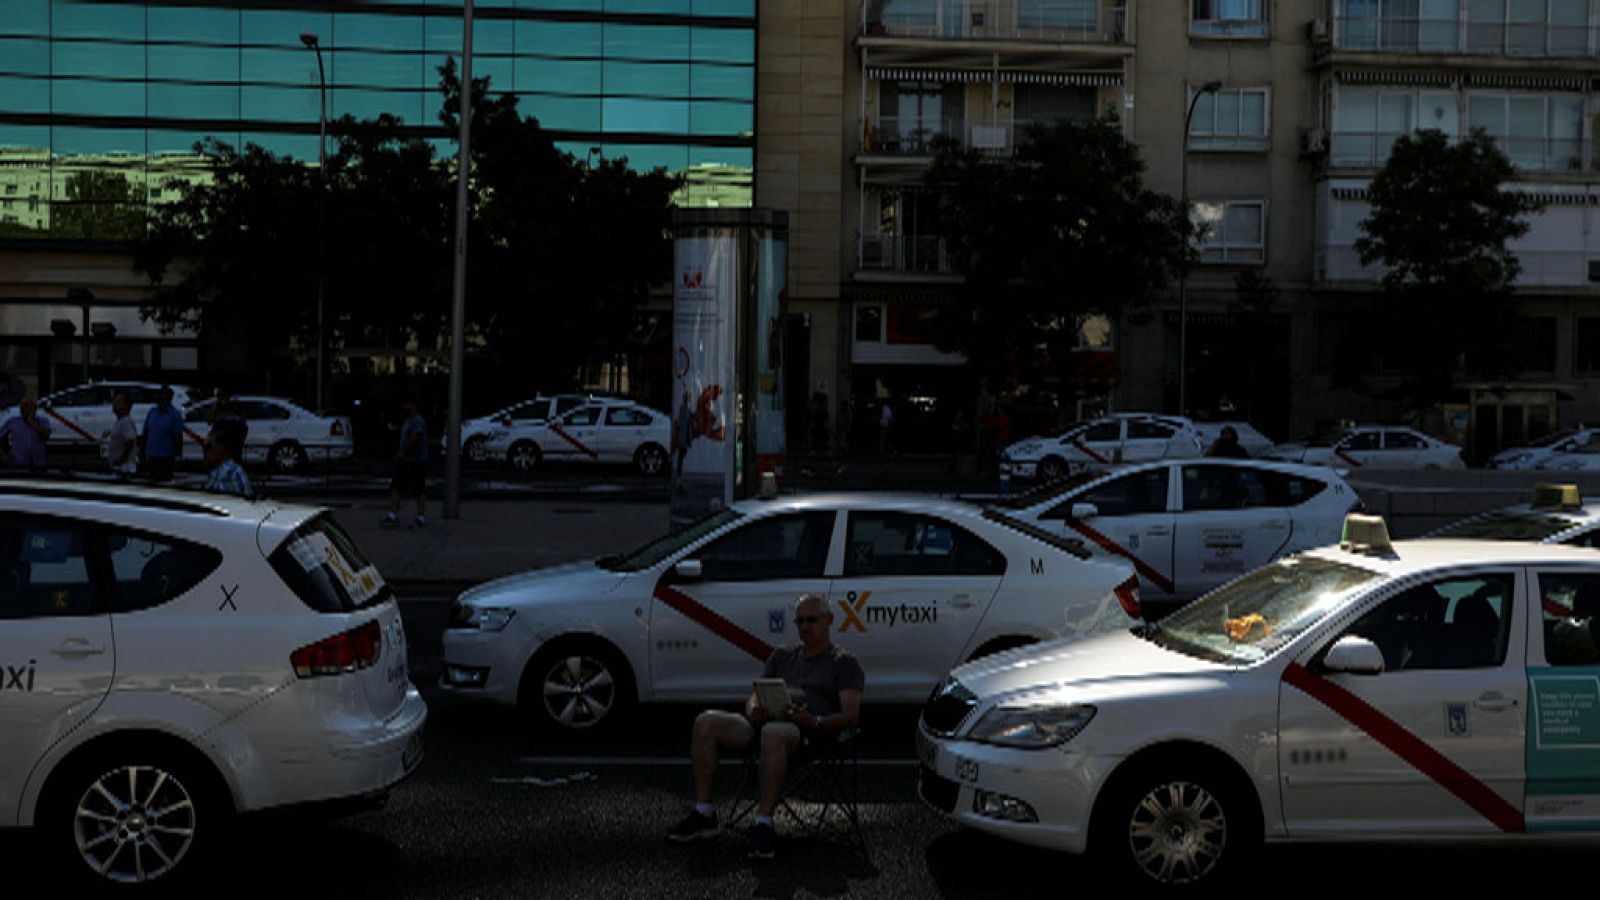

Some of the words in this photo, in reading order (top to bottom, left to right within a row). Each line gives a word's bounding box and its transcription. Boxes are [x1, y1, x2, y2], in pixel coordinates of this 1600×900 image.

[1030, 558, 1045, 575] M
[218, 584, 239, 611] X
[866, 600, 937, 627] mytaxi
[0, 659, 37, 692] xi
